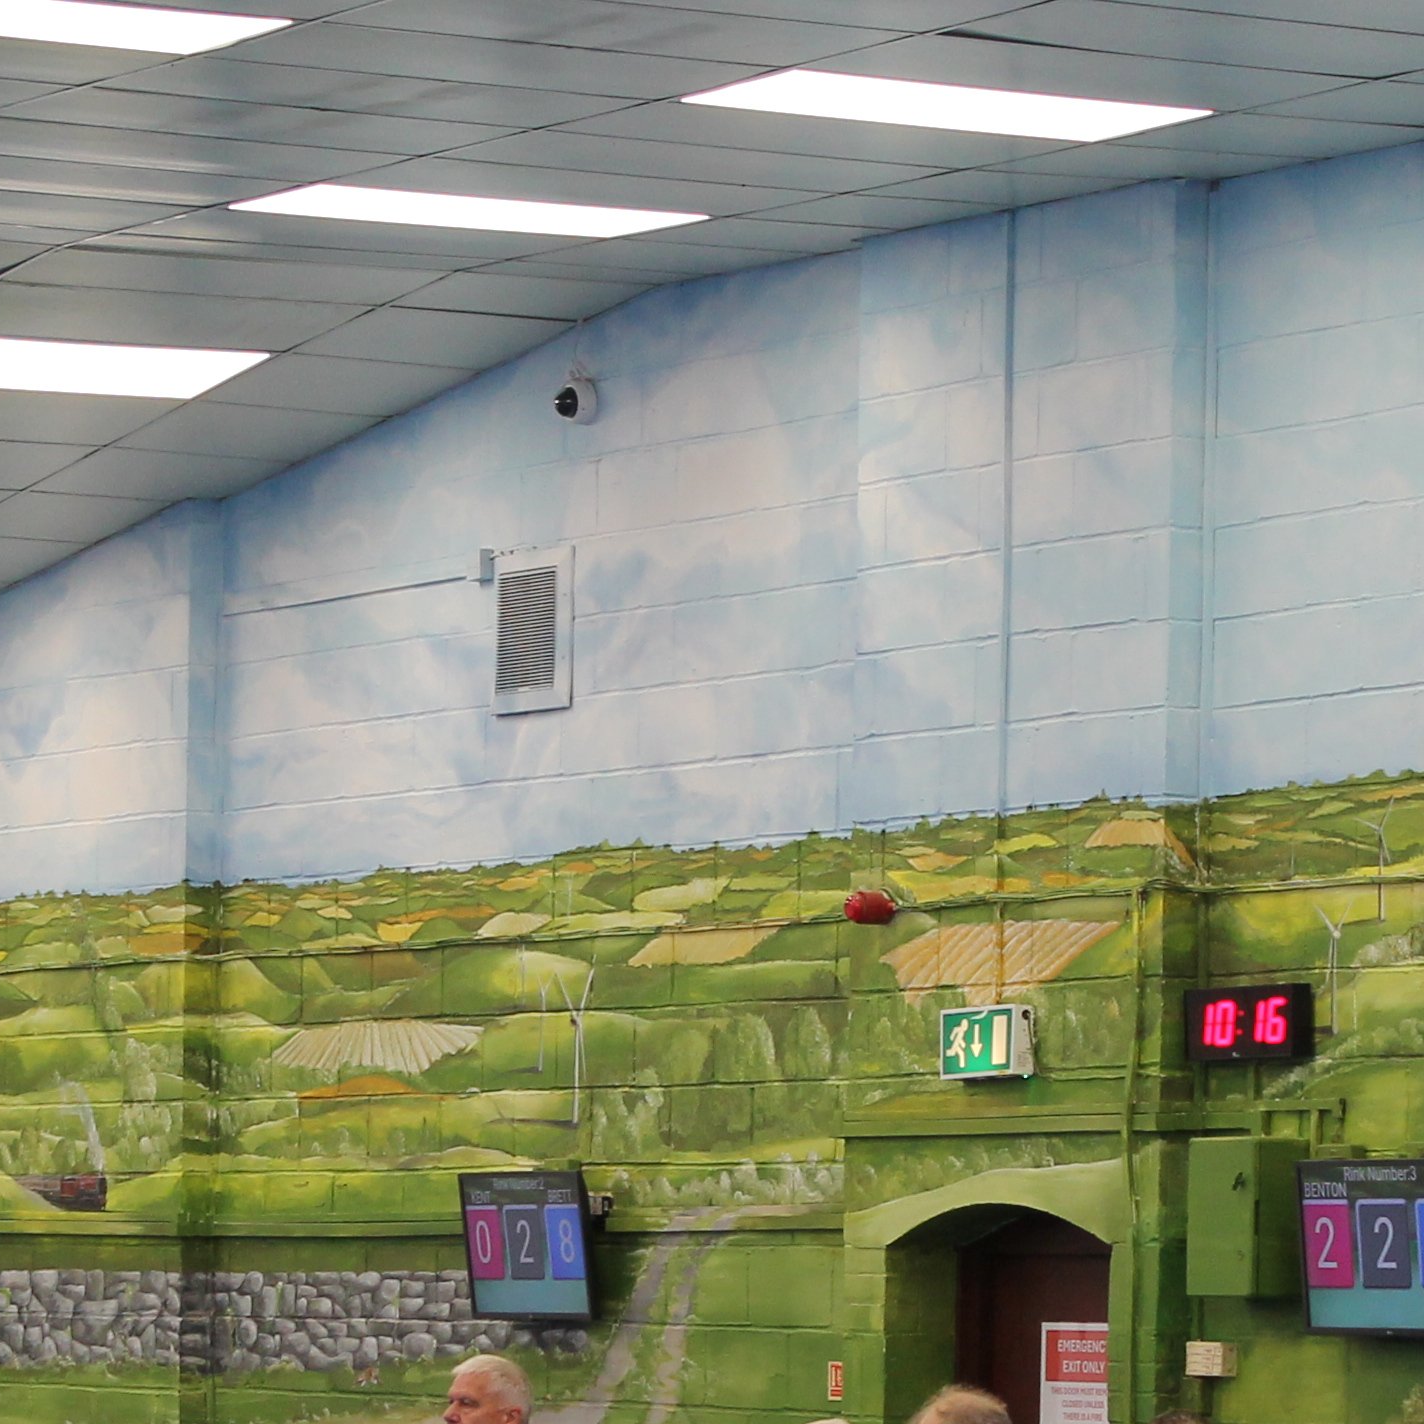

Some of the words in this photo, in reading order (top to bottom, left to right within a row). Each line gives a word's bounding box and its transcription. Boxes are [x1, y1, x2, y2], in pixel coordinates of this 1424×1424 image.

[1203, 995, 1289, 1047] 10:16
[1304, 1182, 1347, 1198] BENTON
[476, 1220, 491, 1264] 0
[516, 1220, 535, 1264] 2
[559, 1219, 575, 1263] 8
[1314, 1217, 1338, 1269] 2
[1374, 1216, 1397, 1269] 2
[1057, 1339, 1106, 1353] EMERGENC
[1062, 1360, 1082, 1373] EXIT
[1082, 1360, 1106, 1374] ONLY
